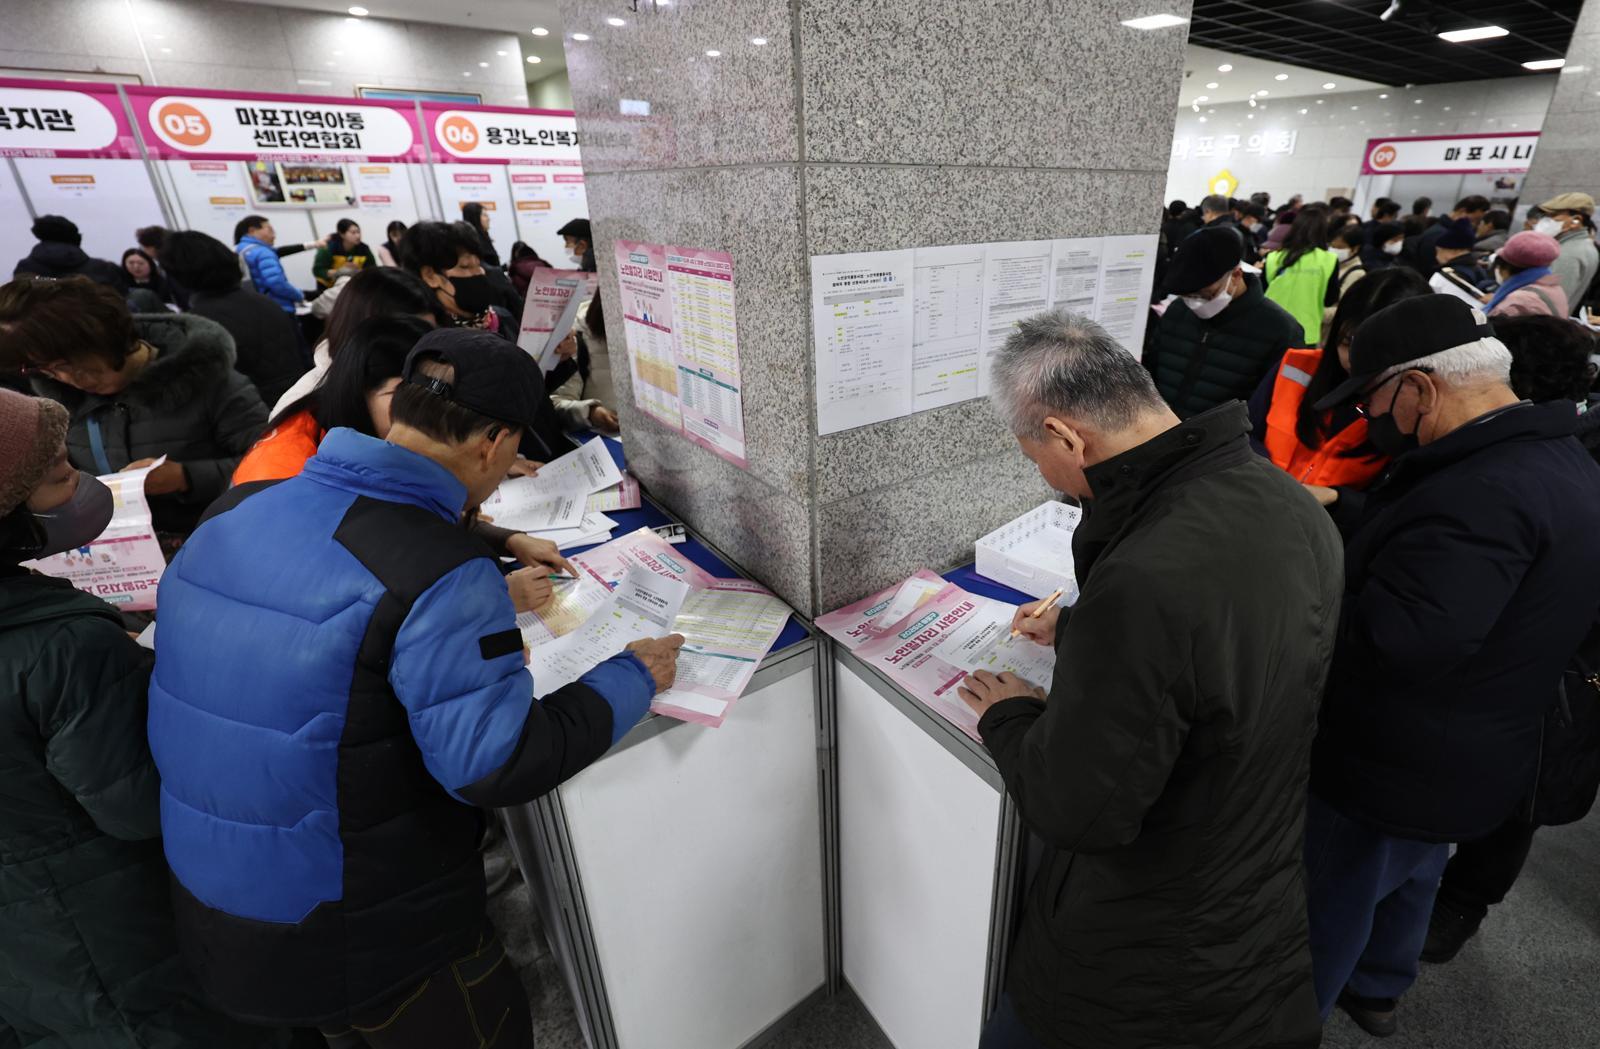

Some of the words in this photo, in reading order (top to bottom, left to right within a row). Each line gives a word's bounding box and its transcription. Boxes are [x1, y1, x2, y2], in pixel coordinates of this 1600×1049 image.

[164, 114, 206, 137] 05
[235, 107, 365, 130] 마포지역아동
[254, 130, 362, 149] 센터연합회
[445, 125, 475, 144] 06
[1173, 130, 1298, 160] 마포구의회
[1444, 145, 1533, 161] 마포시니
[885, 628, 940, 664] 노인일자리
[935, 600, 975, 630] 사업안내
